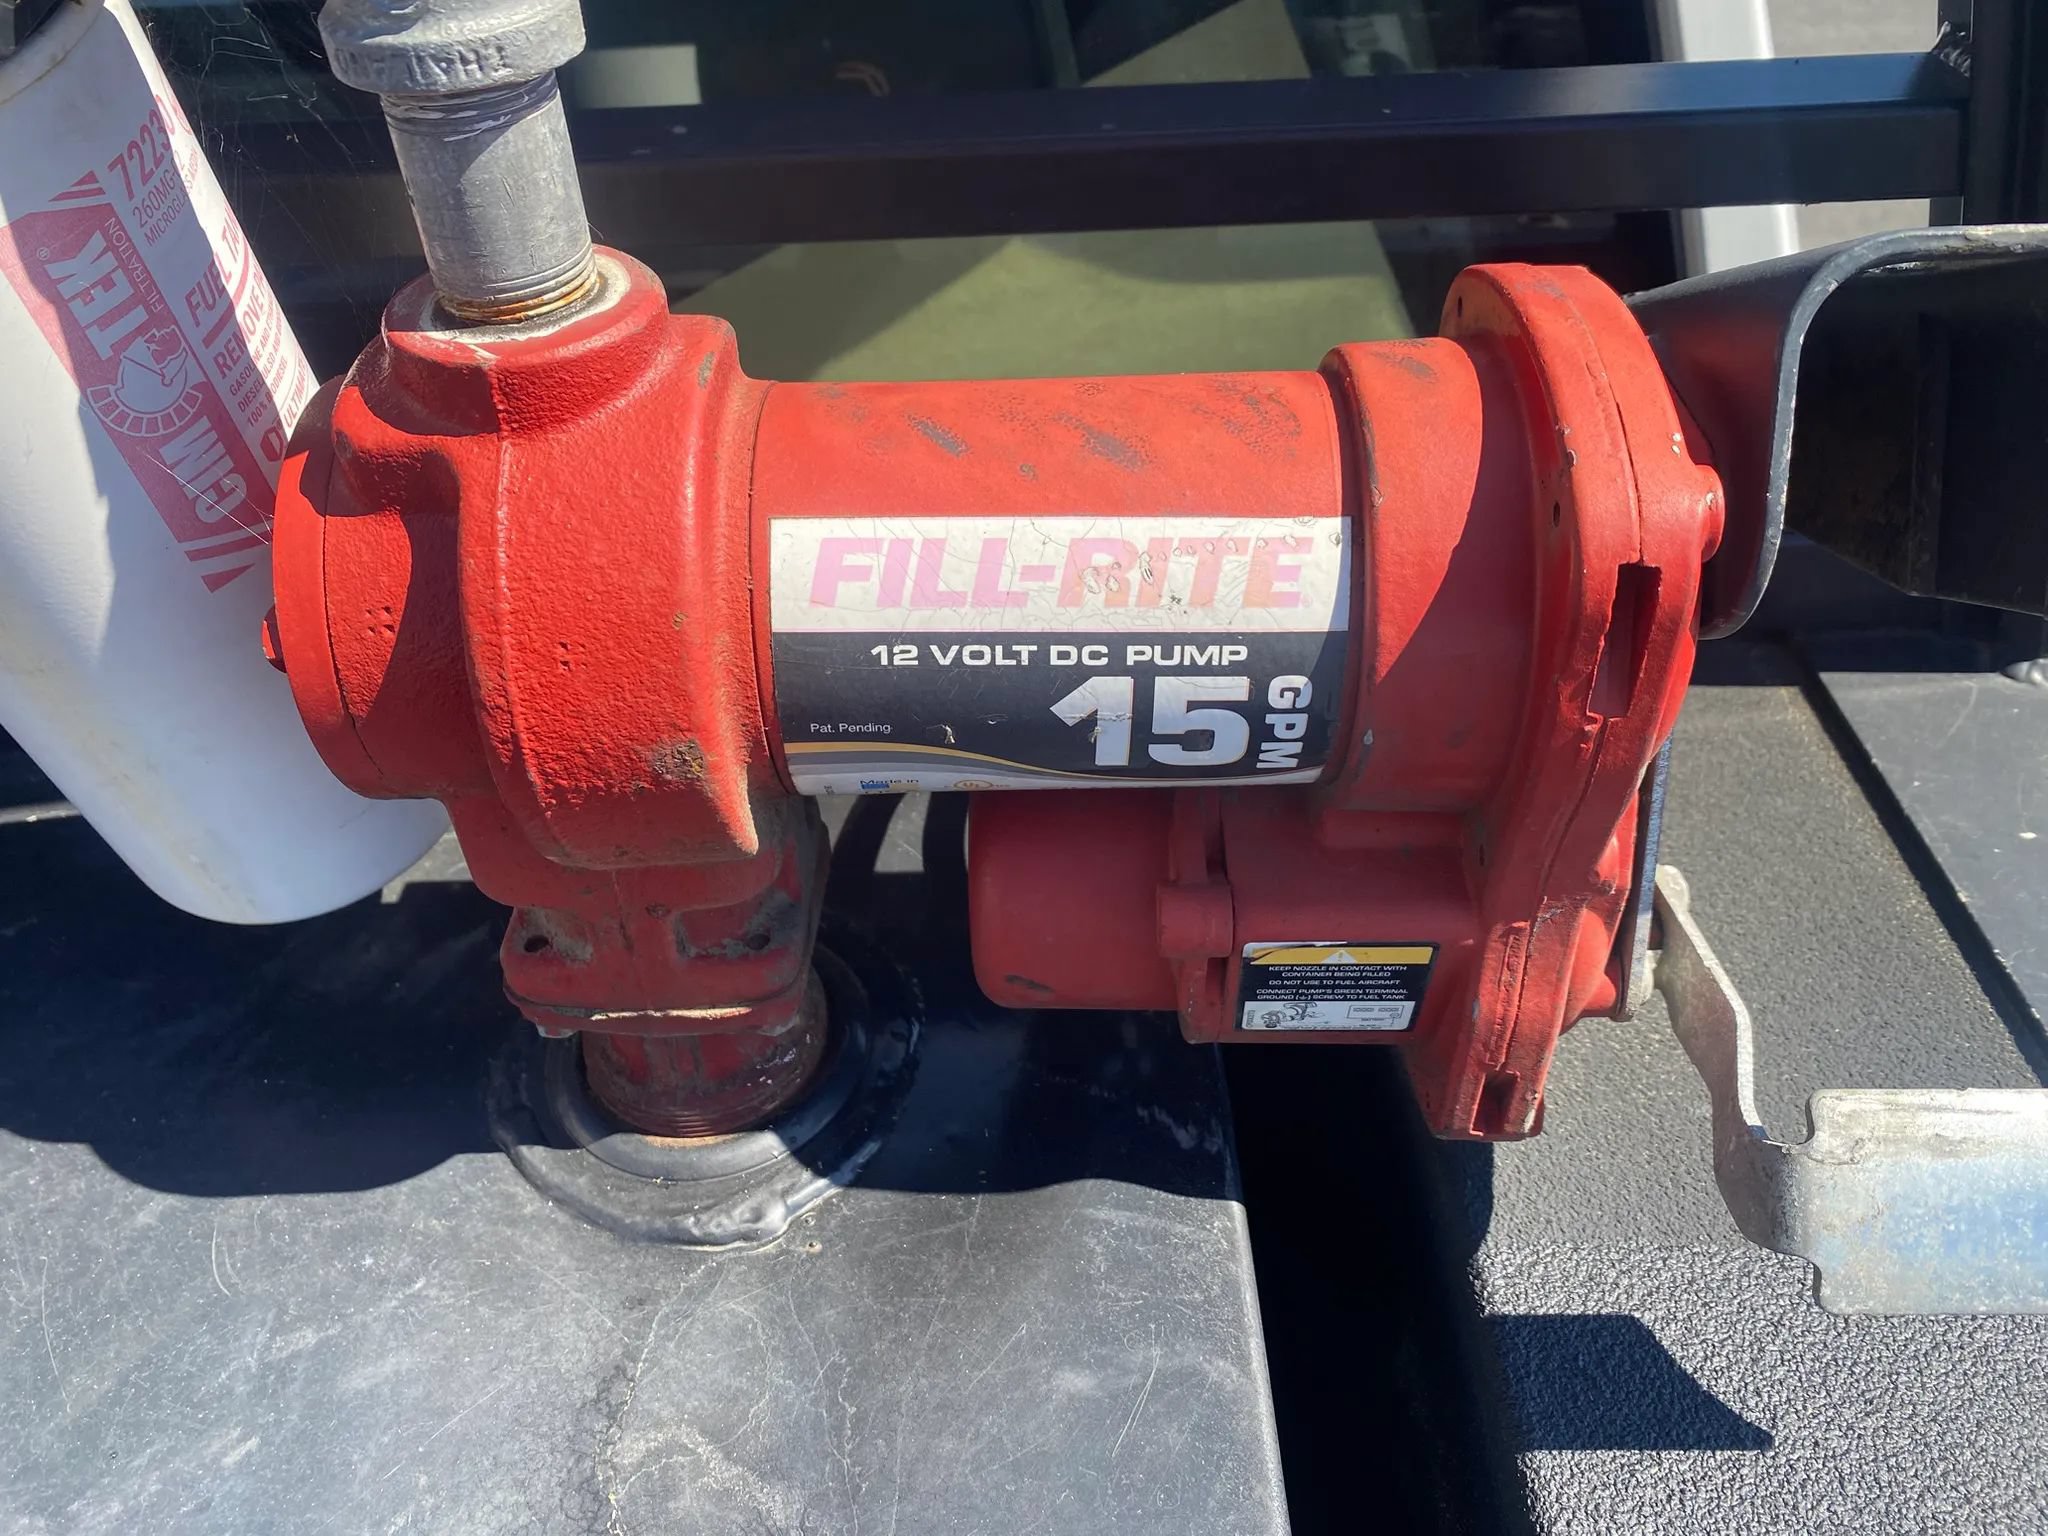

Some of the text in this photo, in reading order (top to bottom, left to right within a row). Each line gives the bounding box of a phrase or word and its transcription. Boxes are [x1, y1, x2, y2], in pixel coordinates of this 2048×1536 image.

[105, 217, 164, 313] FILTRATION
[184, 251, 232, 328] FUEL
[213, 285, 264, 379] REMOVE
[43, 230, 247, 523] CIM TEK
[229, 346, 262, 396] GASOLINE
[809, 536, 1314, 609] FILL-RITE
[870, 644, 1249, 667] 12 VOLT DC PUMP
[810, 722, 892, 736] Pat. Pending
[1049, 674, 1313, 769] 15 GPM
